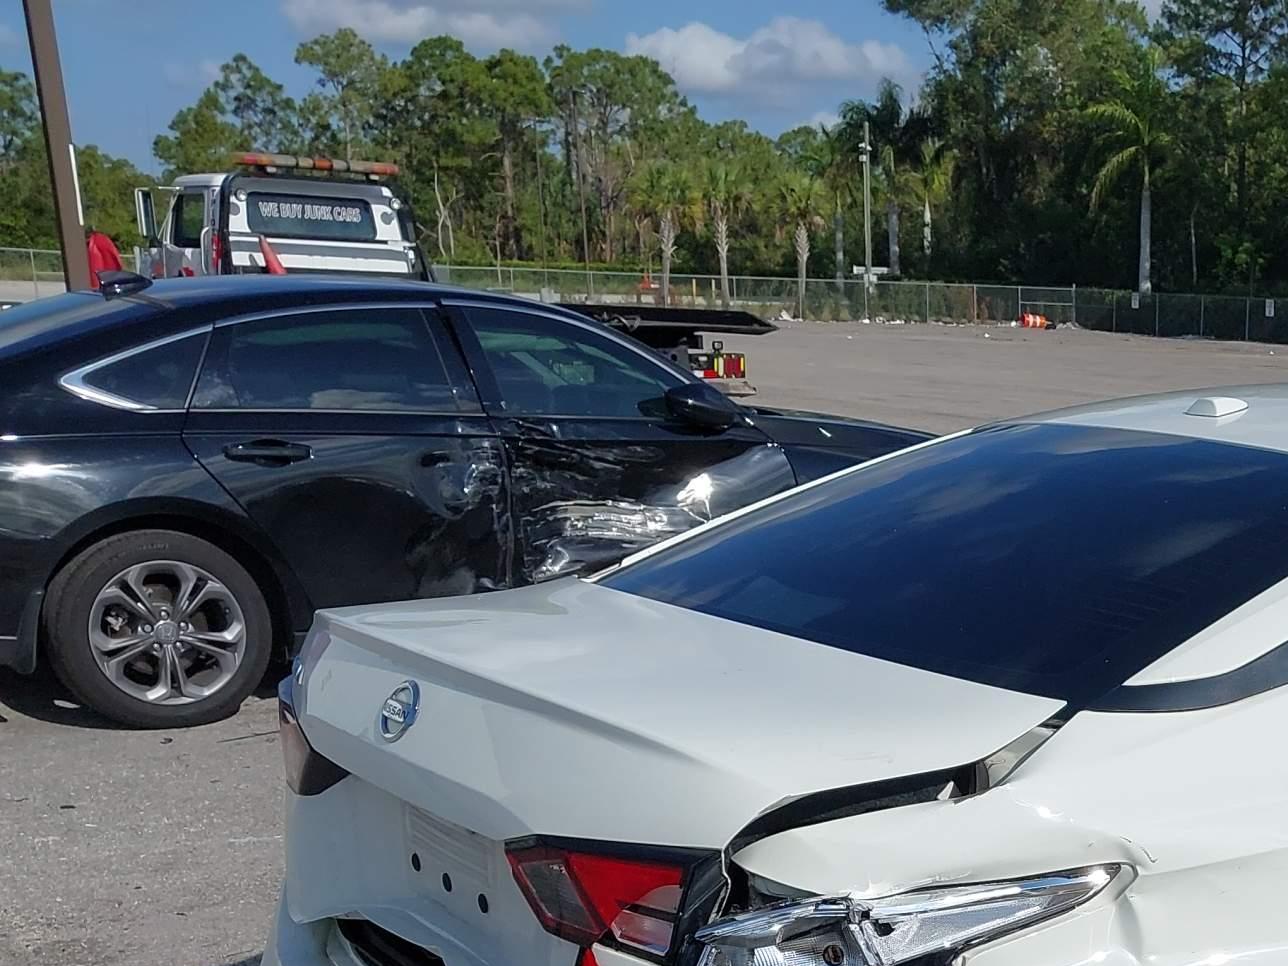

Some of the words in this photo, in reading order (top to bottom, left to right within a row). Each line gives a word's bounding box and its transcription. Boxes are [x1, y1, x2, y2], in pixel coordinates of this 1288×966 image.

[258, 201, 279, 218] WE
[279, 203, 302, 219] BUY
[304, 204, 333, 221] JUNK
[333, 206, 362, 223] CARS
